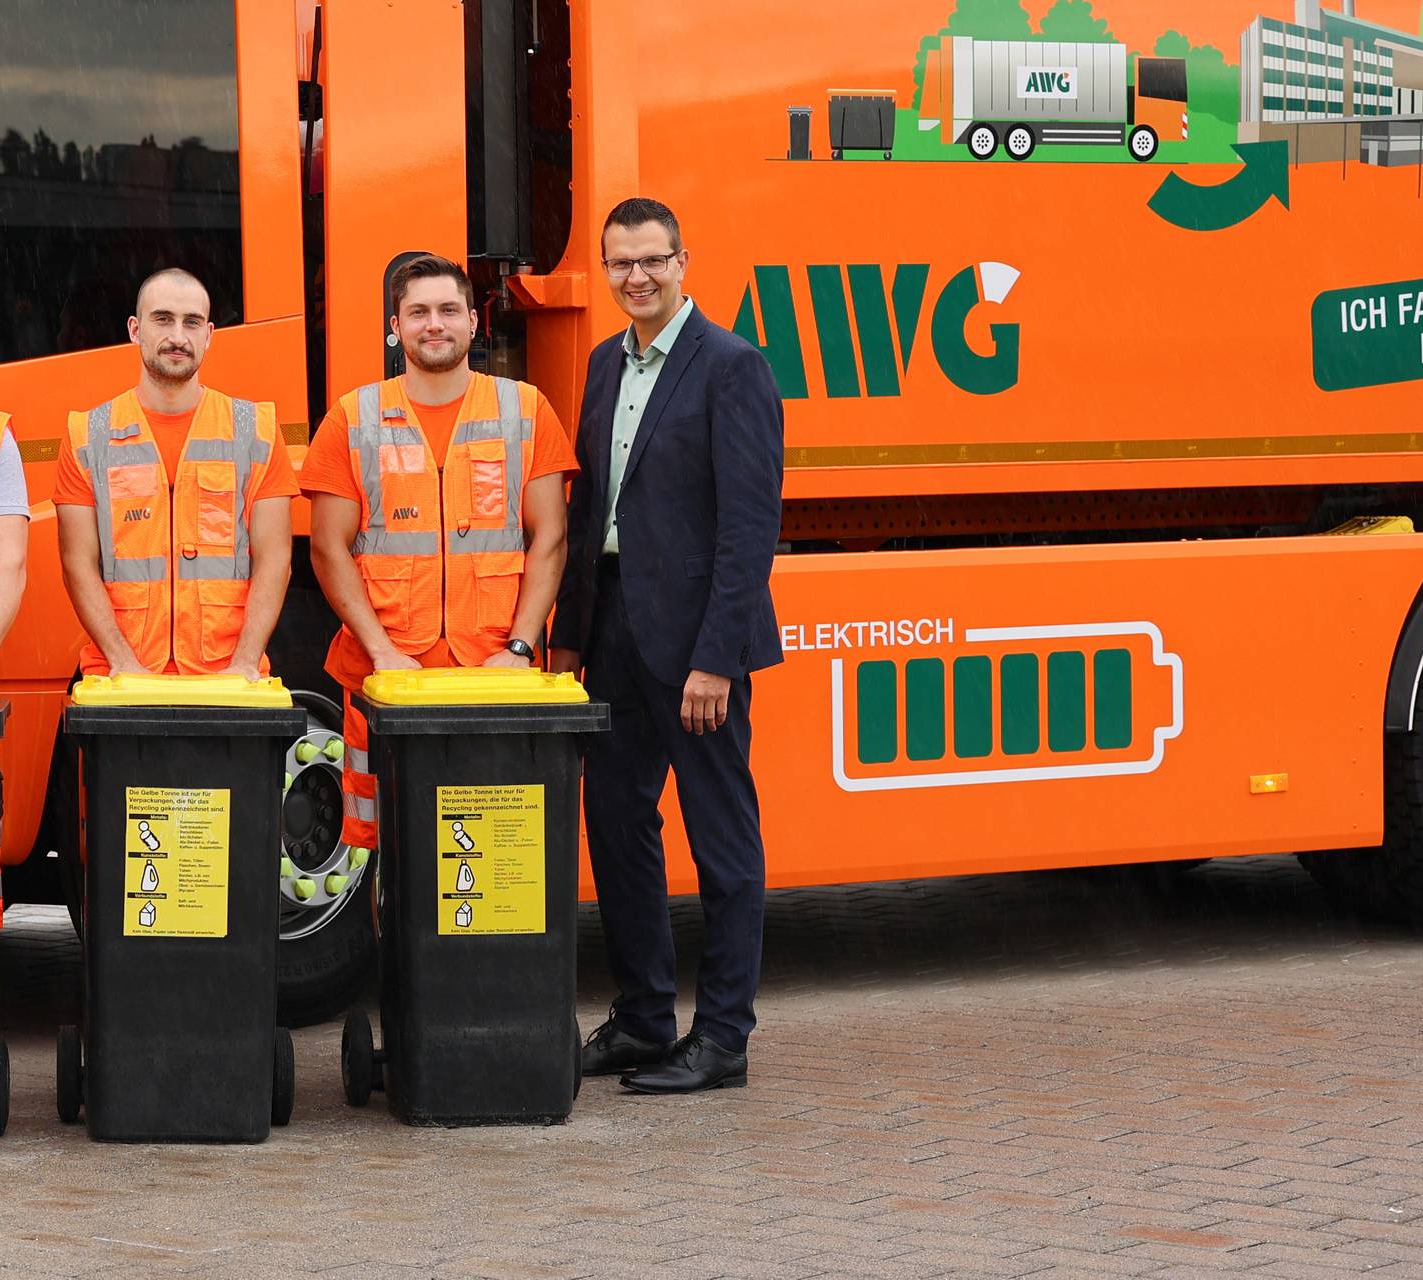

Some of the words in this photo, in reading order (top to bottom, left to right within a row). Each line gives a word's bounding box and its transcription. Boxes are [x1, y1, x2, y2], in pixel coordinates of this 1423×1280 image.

[1026, 72, 1070, 93] AWG
[1340, 298, 1386, 333] ICH
[731, 261, 1021, 399] AWG
[124, 508, 150, 521] AWG
[392, 507, 418, 520] AWG
[780, 618, 954, 651] ELEKTRISCH
